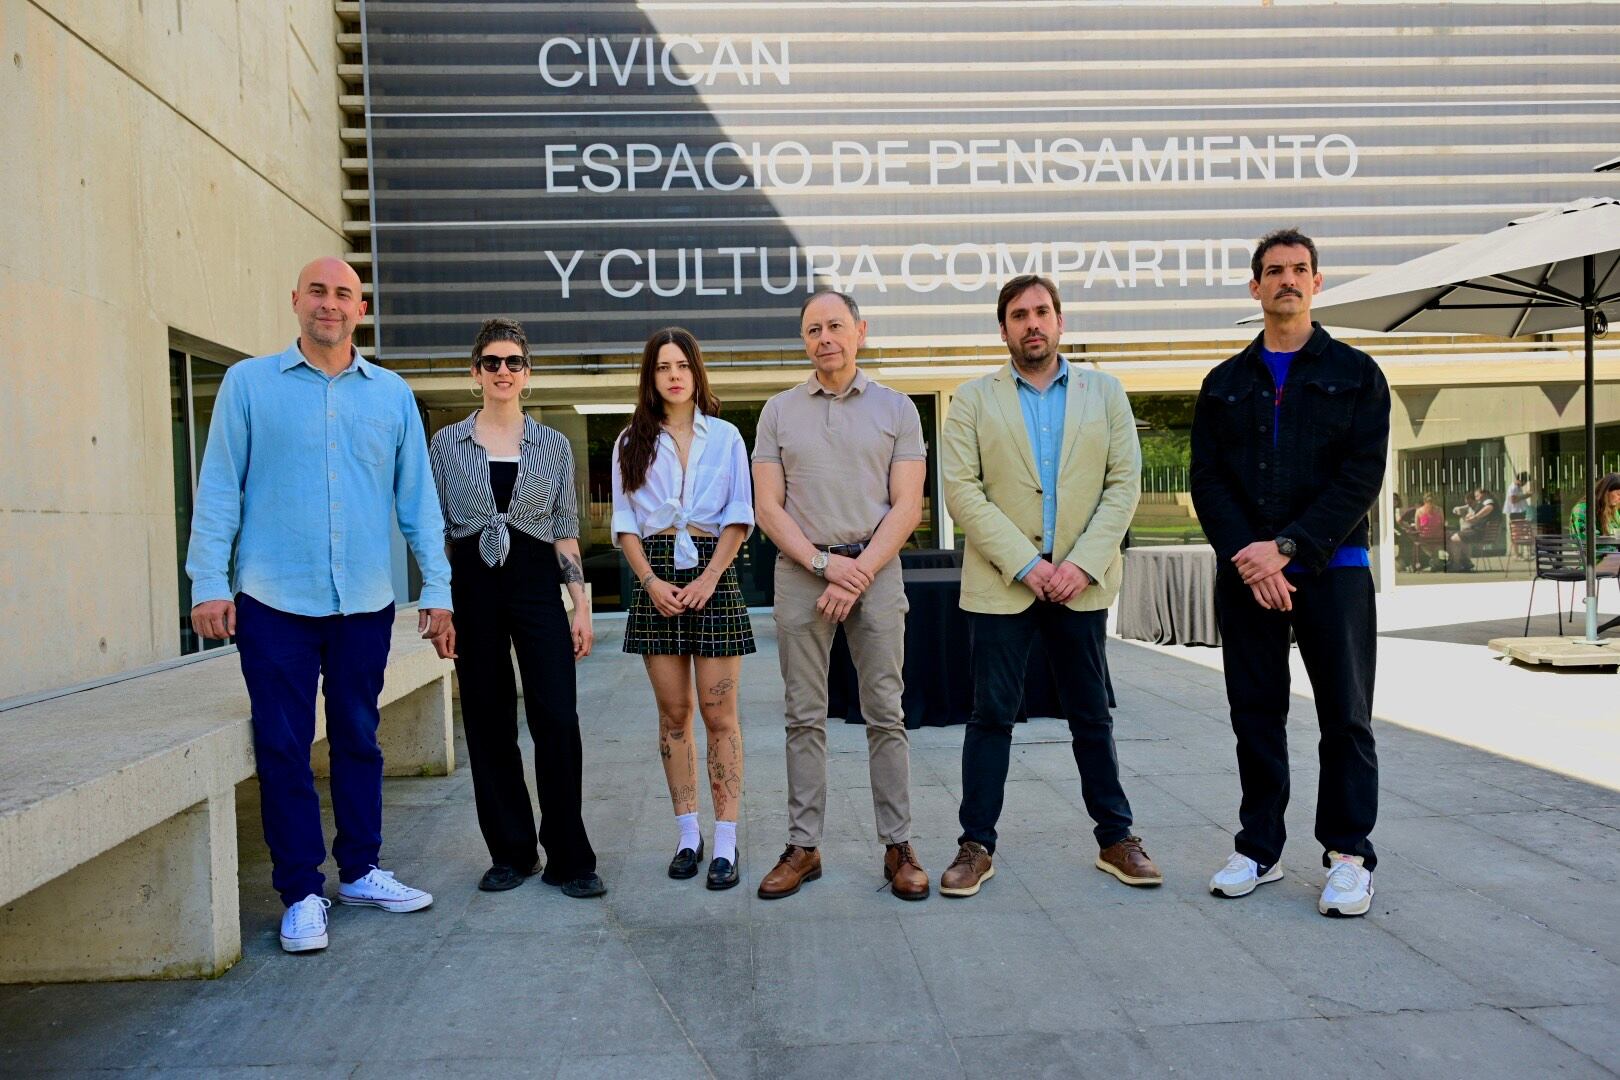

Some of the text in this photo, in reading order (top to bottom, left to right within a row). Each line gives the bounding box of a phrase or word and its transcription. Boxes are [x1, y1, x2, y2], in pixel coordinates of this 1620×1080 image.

[538, 36, 791, 88] CIVICAN
[545, 133, 1358, 194] ESPACIO DE PENSAMIENTO
[544, 238, 1257, 299] Y CULTURA COMPARTID
